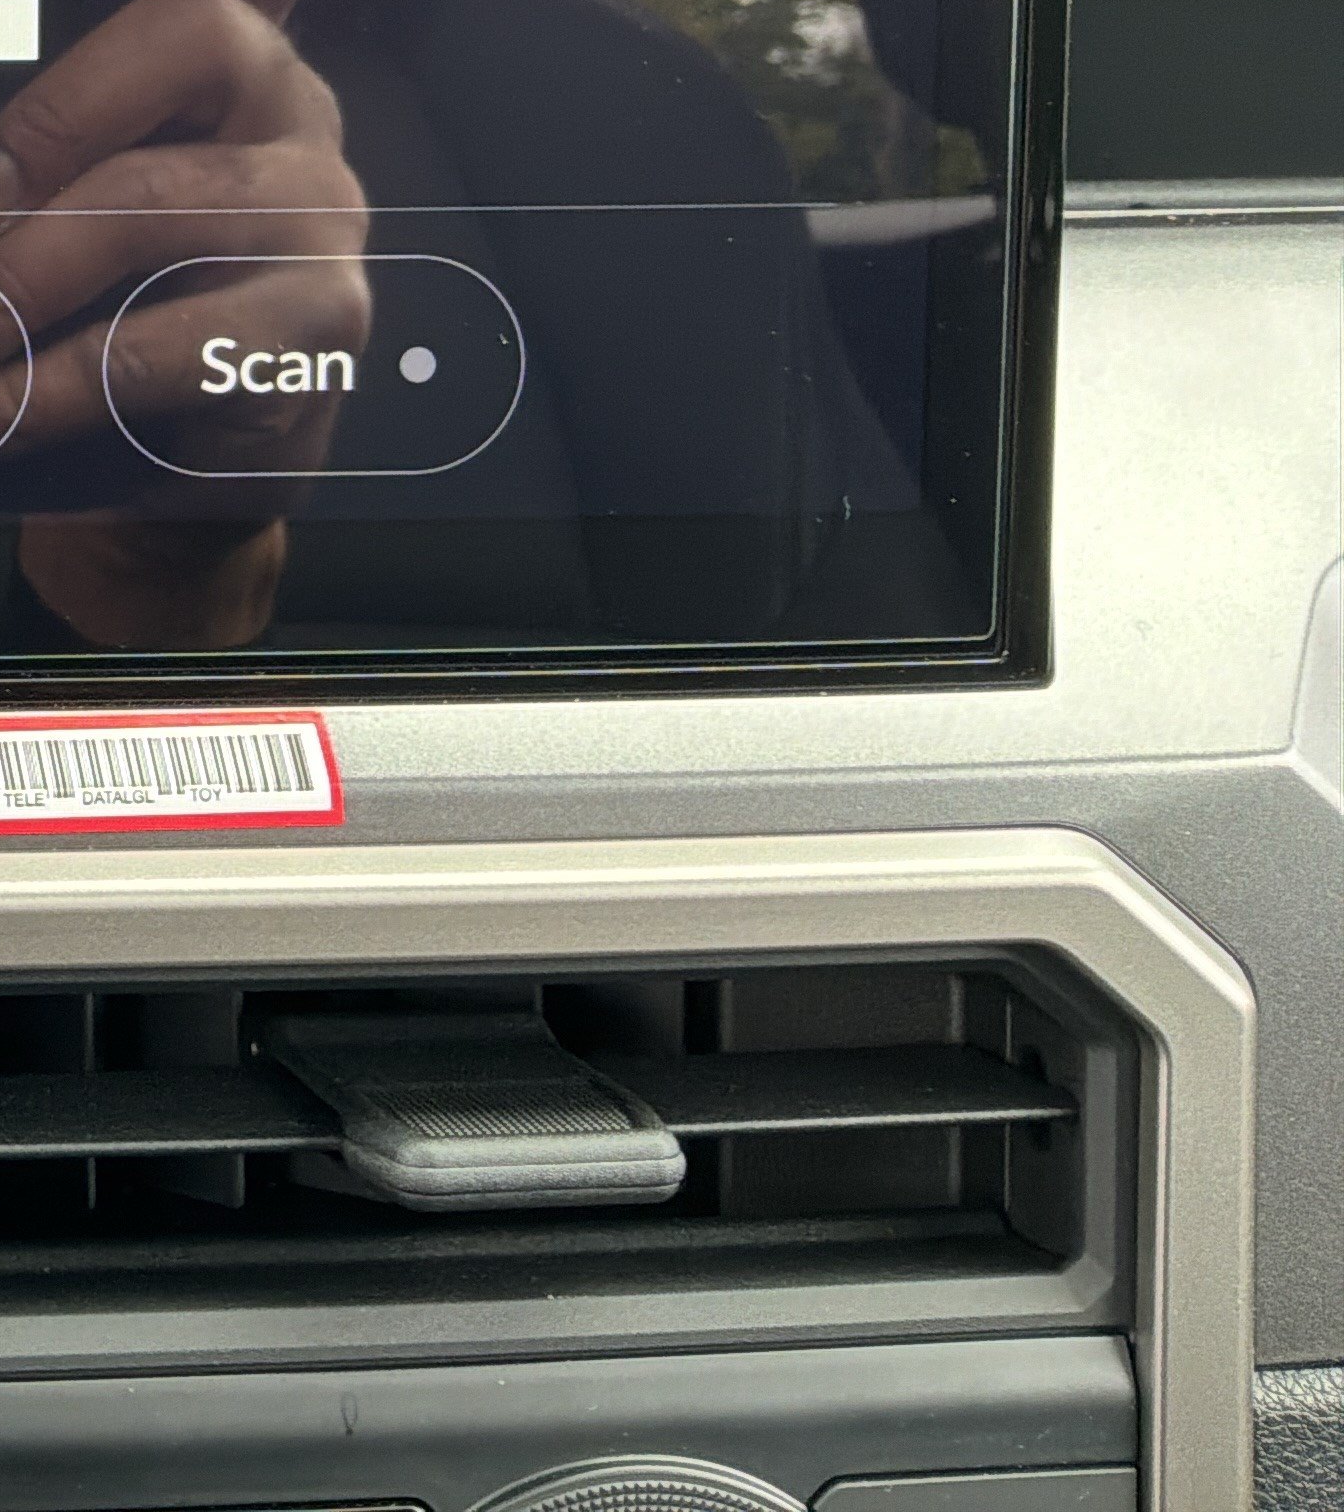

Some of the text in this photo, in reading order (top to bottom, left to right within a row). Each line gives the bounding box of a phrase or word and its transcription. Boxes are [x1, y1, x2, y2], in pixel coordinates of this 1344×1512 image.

[200, 337, 354, 394] Scan
[3, 787, 222, 808] TELE DATALGL TOY
